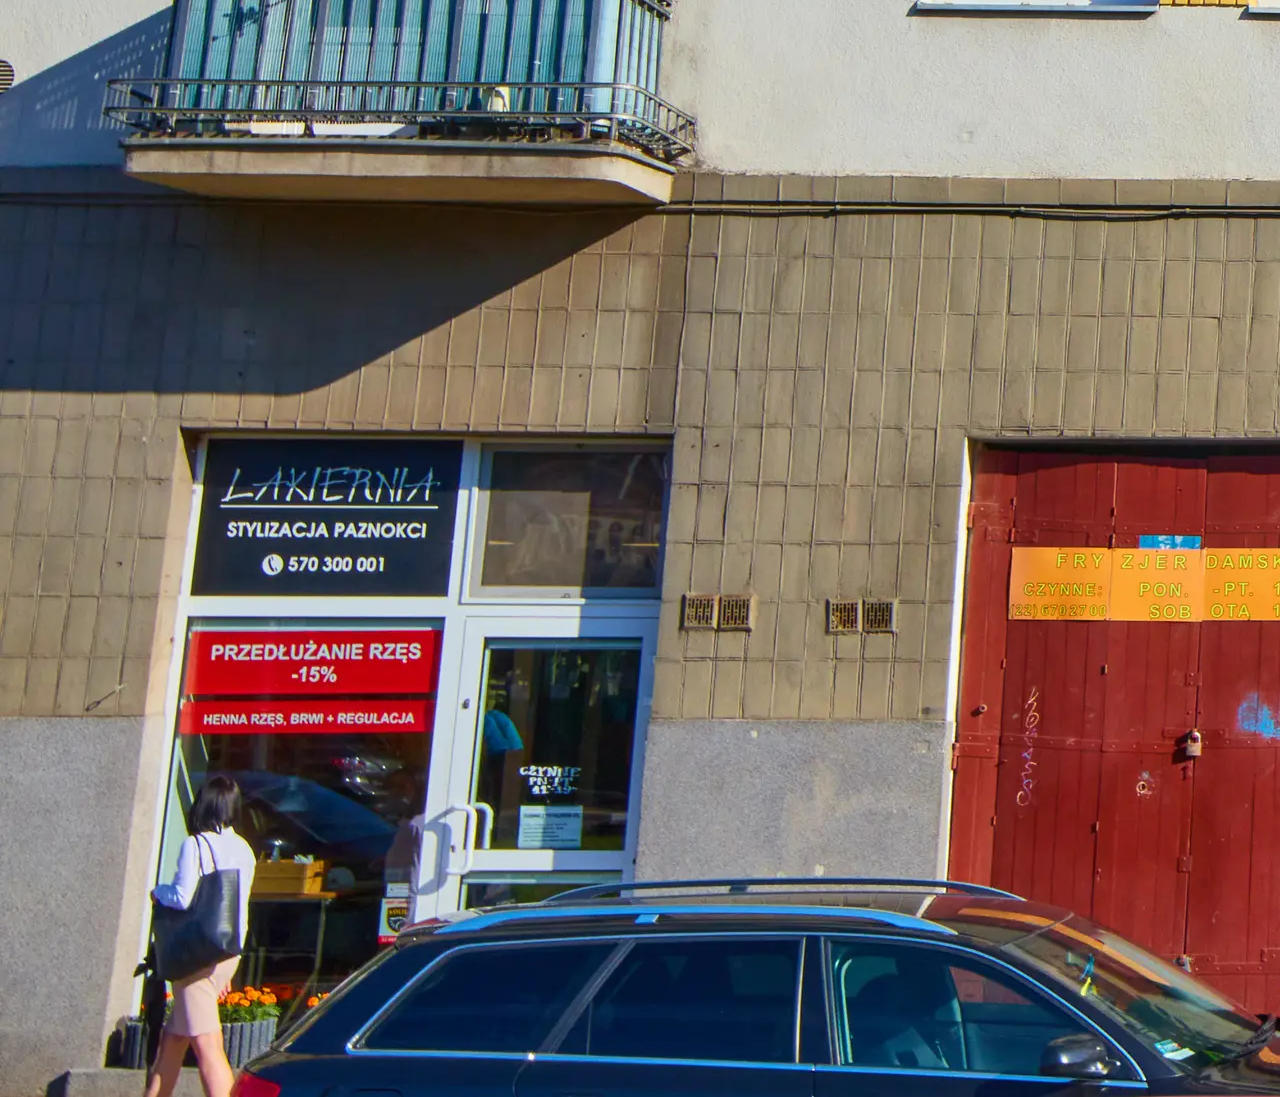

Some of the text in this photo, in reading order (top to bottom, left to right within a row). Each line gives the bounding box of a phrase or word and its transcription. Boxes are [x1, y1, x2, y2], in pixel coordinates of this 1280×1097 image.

[221, 467, 441, 503] LAKIERNIA
[227, 521, 427, 539] STYLIZACJA PAZNOKCI
[288, 556, 385, 572] 570 300 001
[1023, 582, 1103, 597] CZYNNE:
[211, 640, 422, 663] PRZEDŁUŻANIE RZĘS
[291, 666, 338, 683] -15%
[203, 714, 248, 725] HENNA
[250, 713, 287, 727] RZĘS,
[290, 713, 323, 724] BRWI
[337, 712, 415, 724] REGULACJA
